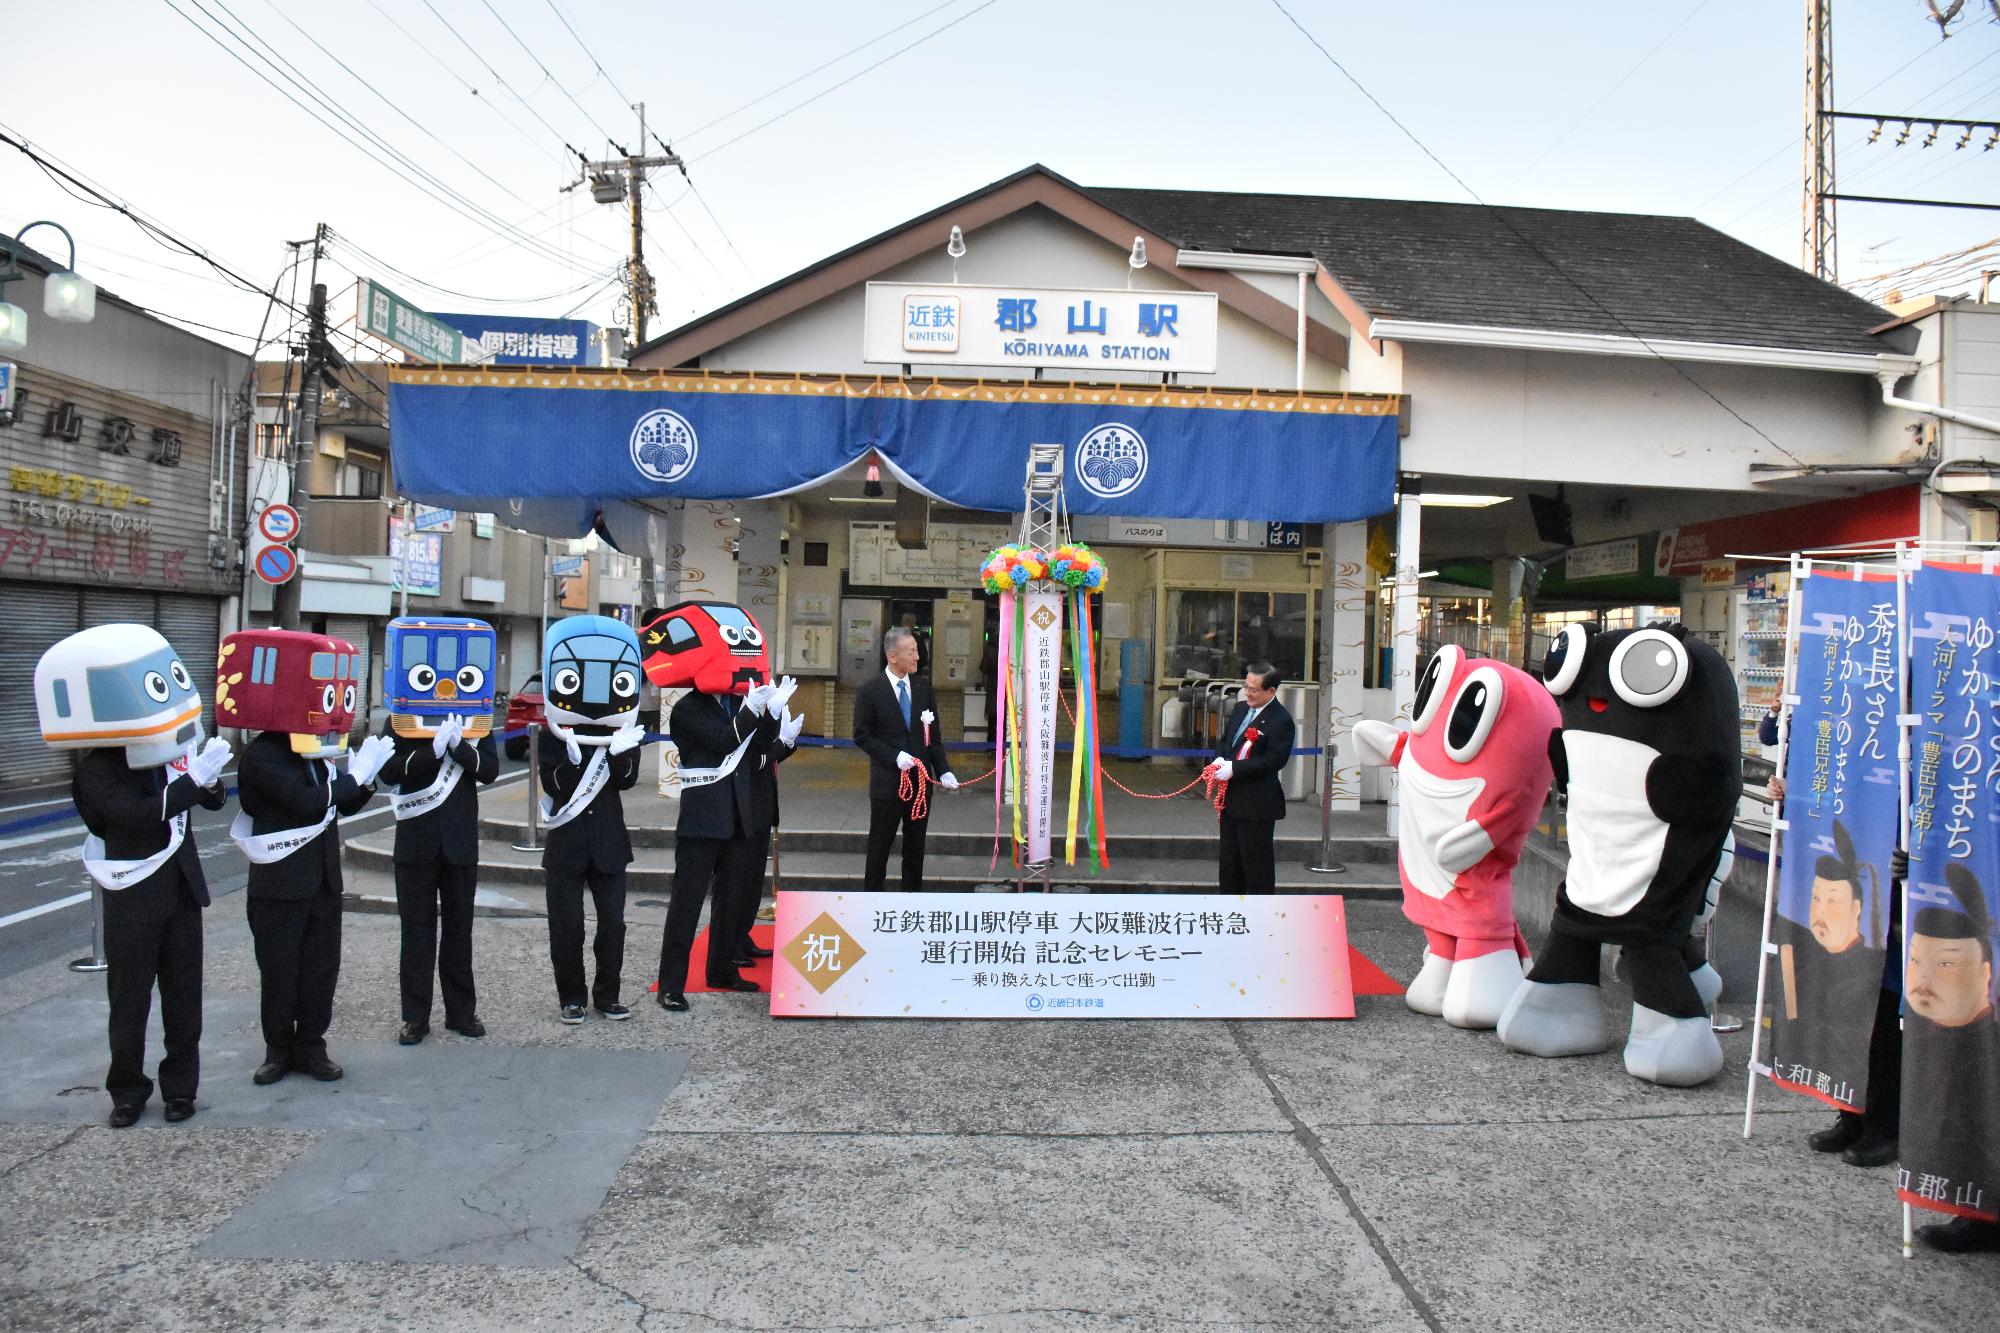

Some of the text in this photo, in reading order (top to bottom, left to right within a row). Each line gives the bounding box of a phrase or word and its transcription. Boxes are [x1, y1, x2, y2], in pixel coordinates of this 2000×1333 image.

[908, 304, 956, 328] 近鉄
[995, 297, 1179, 338] 郡山駅
[481, 330, 578, 359] 個別指導
[908, 331, 955, 342] KINTETSU
[1101, 345, 1171, 361] STATION
[14, 387, 182, 468] 山交通
[1036, 611, 1050, 625] 祝
[1039, 636, 1050, 715] 近鉄郡山駅停車
[1859, 602, 1897, 761] 秀長さん
[1945, 616, 1995, 859] ゆかりのまち
[873, 910, 1252, 936] 近鉄郡山駅停車 大阪難波行特急
[801, 934, 843, 974] 祝
[921, 940, 1202, 965] 運行開始 記念セレモニー
[1046, 996, 1104, 1009] 近畿日本鉄道
